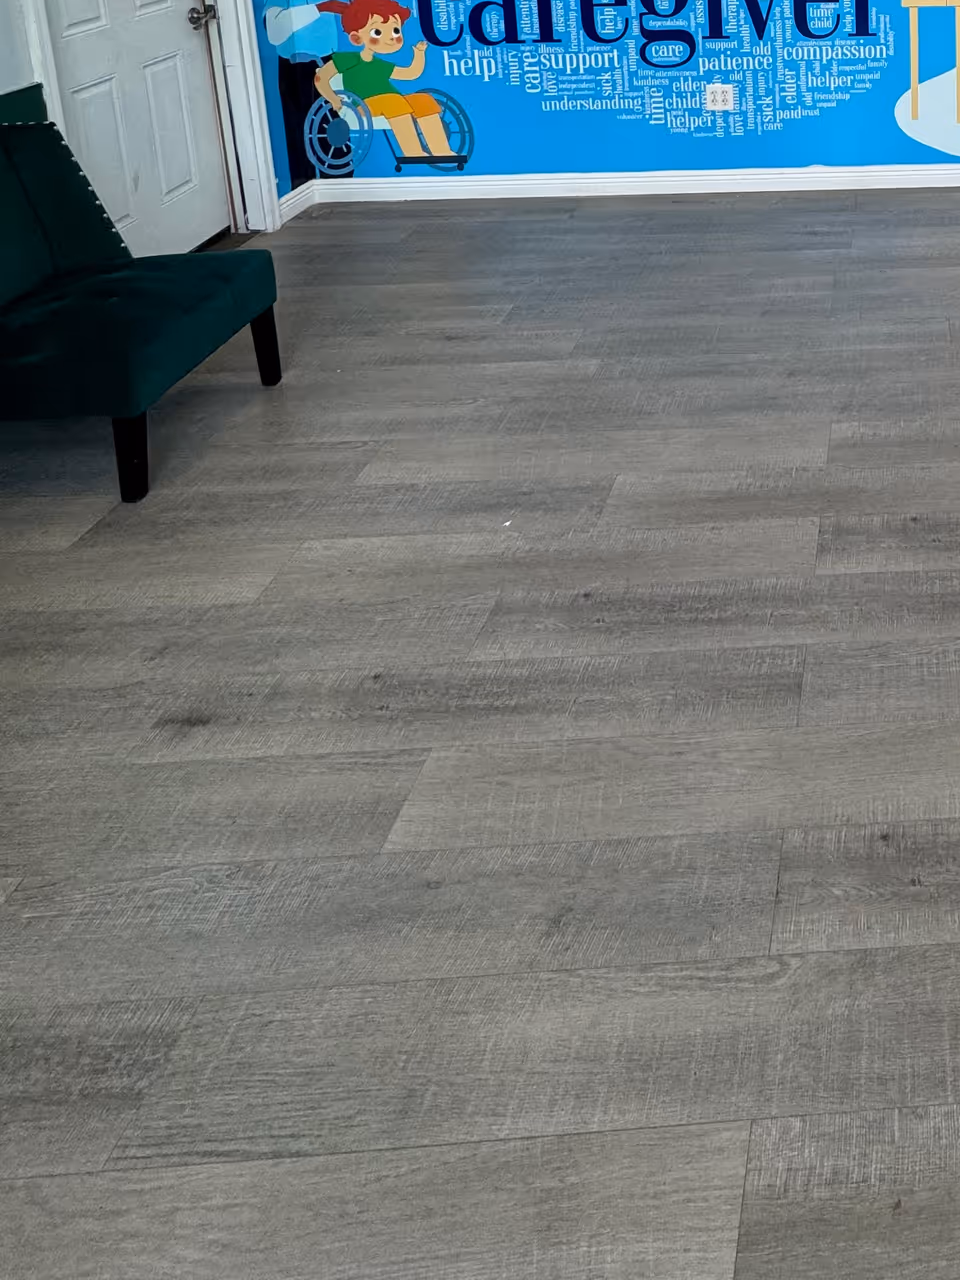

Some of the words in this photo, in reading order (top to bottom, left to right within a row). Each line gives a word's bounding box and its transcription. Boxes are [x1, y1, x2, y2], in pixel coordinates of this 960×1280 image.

[554, 0, 566, 33] disease
[601, 8, 617, 34] help
[809, 5, 834, 17] time
[567, 11, 578, 52] friendship
[631, 18, 640, 36] time
[784, 19, 793, 43] young
[810, 18, 832, 28] child
[843, 14, 853, 32] help
[705, 40, 738, 51] support
[740, 24, 750, 52] health
[753, 41, 772, 56] old
[478, 46, 493, 57] old
[538, 44, 565, 54] illness
[625, 40, 639, 72] unpaid
[652, 44, 683, 57] care
[773, 20, 784, 81] trustworthiness
[784, 39, 887, 64] compassion
[443, 49, 496, 82] help
[506, 49, 522, 86] injury
[522, 51, 541, 93] care
[541, 48, 621, 75] support
[699, 51, 773, 75] patience
[543, 71, 558, 96] love
[613, 68, 623, 98] health
[633, 77, 669, 86] kindness
[638, 69, 655, 78] time
[673, 76, 707, 92] elder
[729, 71, 743, 81] old
[756, 71, 767, 96] injury
[797, 61, 806, 92] informal
[808, 71, 853, 90] helper
[855, 71, 881, 81] unpaid
[596, 72, 613, 97] sick
[780, 68, 797, 104] elder
[542, 95, 642, 112] understanding
[645, 87, 665, 125] time
[665, 92, 701, 109] child
[745, 71, 756, 130] transportation
[802, 92, 813, 106] old
[814, 92, 850, 101] friendship
[757, 95, 774, 123] sick
[776, 105, 802, 122] paid
[801, 108, 820, 116] trust
[667, 111, 714, 131] helper
[731, 114, 744, 136] love
[763, 121, 783, 131] care
